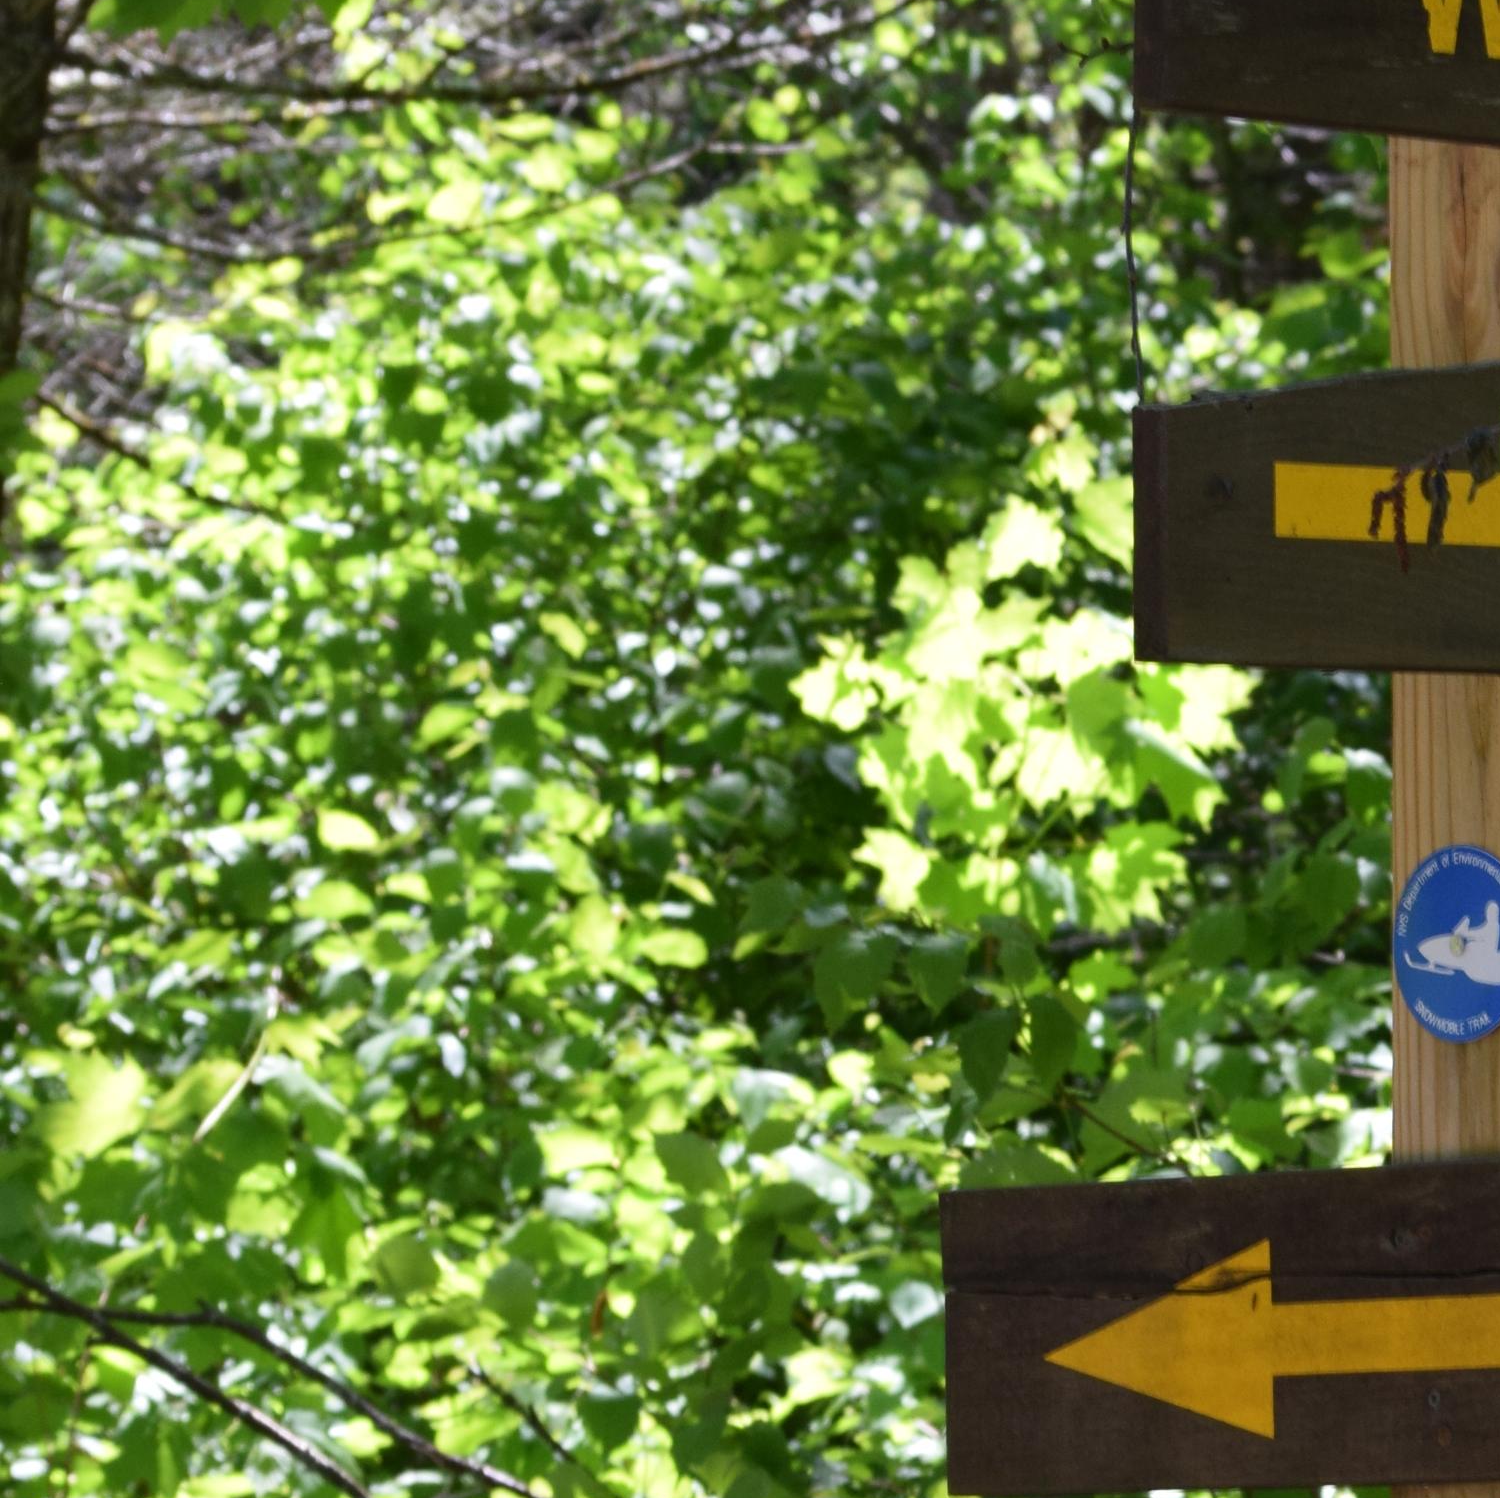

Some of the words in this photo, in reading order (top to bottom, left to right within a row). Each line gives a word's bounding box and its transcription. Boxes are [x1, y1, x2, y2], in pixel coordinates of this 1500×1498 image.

[1441, 854, 1450, 869] of
[1402, 861, 1440, 912] Department
[1397, 912, 1409, 938] NYS
[1414, 998, 1465, 1036] SNOWMOBILE
[1467, 1011, 1491, 1035] TRAIL
